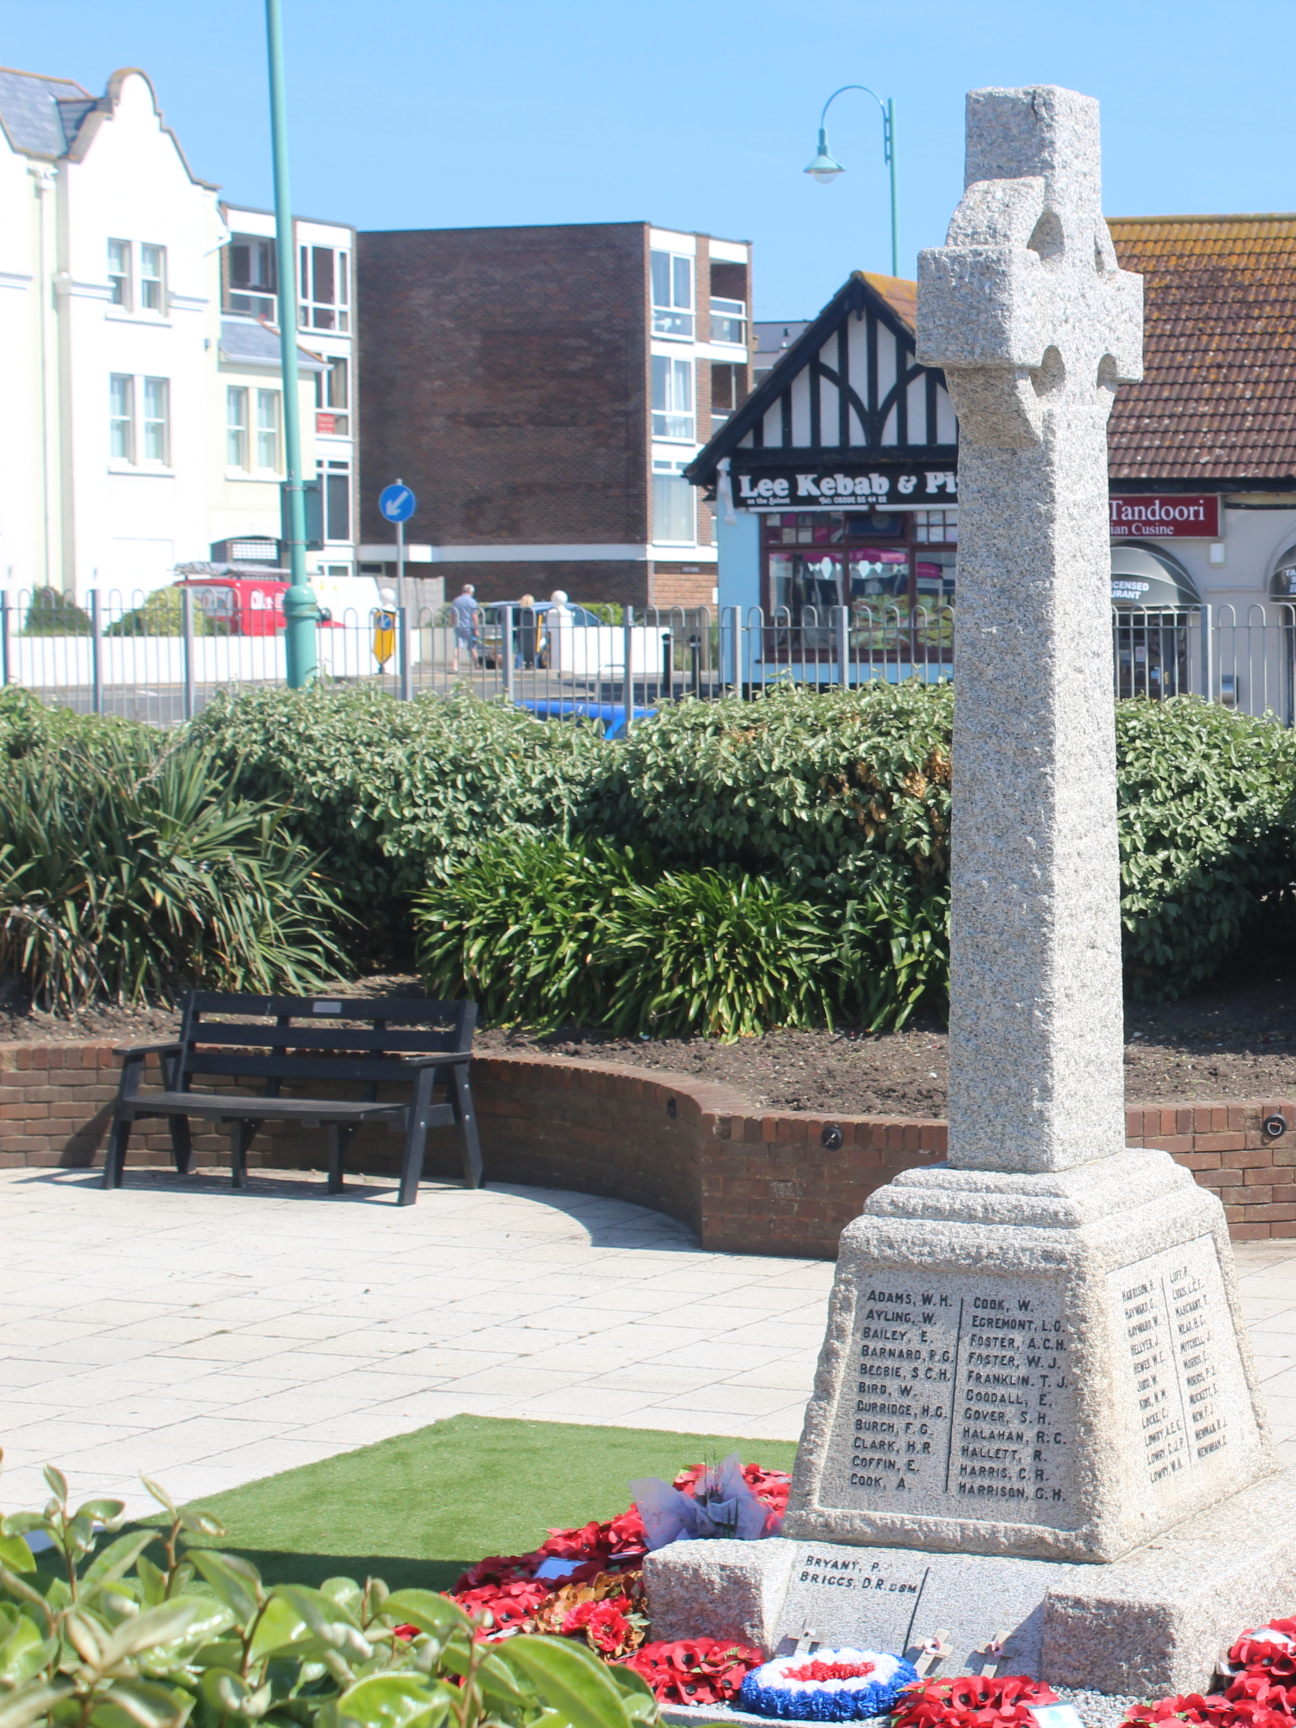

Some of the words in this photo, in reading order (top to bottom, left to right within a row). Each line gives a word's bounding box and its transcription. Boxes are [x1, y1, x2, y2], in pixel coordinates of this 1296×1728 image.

[738, 475, 789, 497] Lee
[795, 473, 889, 496] Kebab
[897, 475, 917, 494] &
[924, 472, 958, 493] Pi
[1109, 499, 1205, 521] Tandoori
[1110, 522, 1128, 535] ian
[1131, 522, 1174, 535] Cusine
[1110, 581, 1149, 592] CENSED
[1110, 590, 1142, 600] URANT
[866, 1290, 916, 1307] ADAMS,
[974, 1297, 1009, 1313] COOK,
[1018, 1300, 1034, 1312] W.
[865, 1309, 915, 1326] AYLING,
[922, 1312, 936, 1324] W.
[972, 1316, 1037, 1333] EGREMONT,
[863, 1327, 910, 1342] BAILEY,
[921, 1330, 934, 1343] E.
[970, 1334, 1020, 1350] FOSTER,
[862, 1344, 926, 1362] BARNARD,
[968, 1352, 1020, 1368] FOSTER,
[858, 1382, 892, 1397] BIRD,
[900, 1384, 917, 1396] W.
[966, 1389, 1028, 1407] GOODALL,
[1039, 1394, 1052, 1407] E.
[857, 1400, 918, 1418] BURRIDGE,
[964, 1407, 1009, 1425] GOVER,
[856, 1418, 899, 1435] BURCH,
[963, 1426, 1029, 1445] HALAHAN,
[854, 1436, 900, 1454] CLARK,
[962, 1444, 1022, 1463] HALLETT,
[1034, 1450, 1047, 1462] R.
[852, 1455, 900, 1472] COFFIN,
[908, 1460, 920, 1472] E.
[960, 1464, 1012, 1480] HARRIS,
[850, 1472, 886, 1490] COOK,
[896, 1477, 912, 1491] A.
[958, 1482, 1028, 1500] HARRISON,
[806, 1555, 862, 1573] BRYANT,
[870, 1562, 882, 1572] P.
[800, 1571, 858, 1589] BRIGGS,
